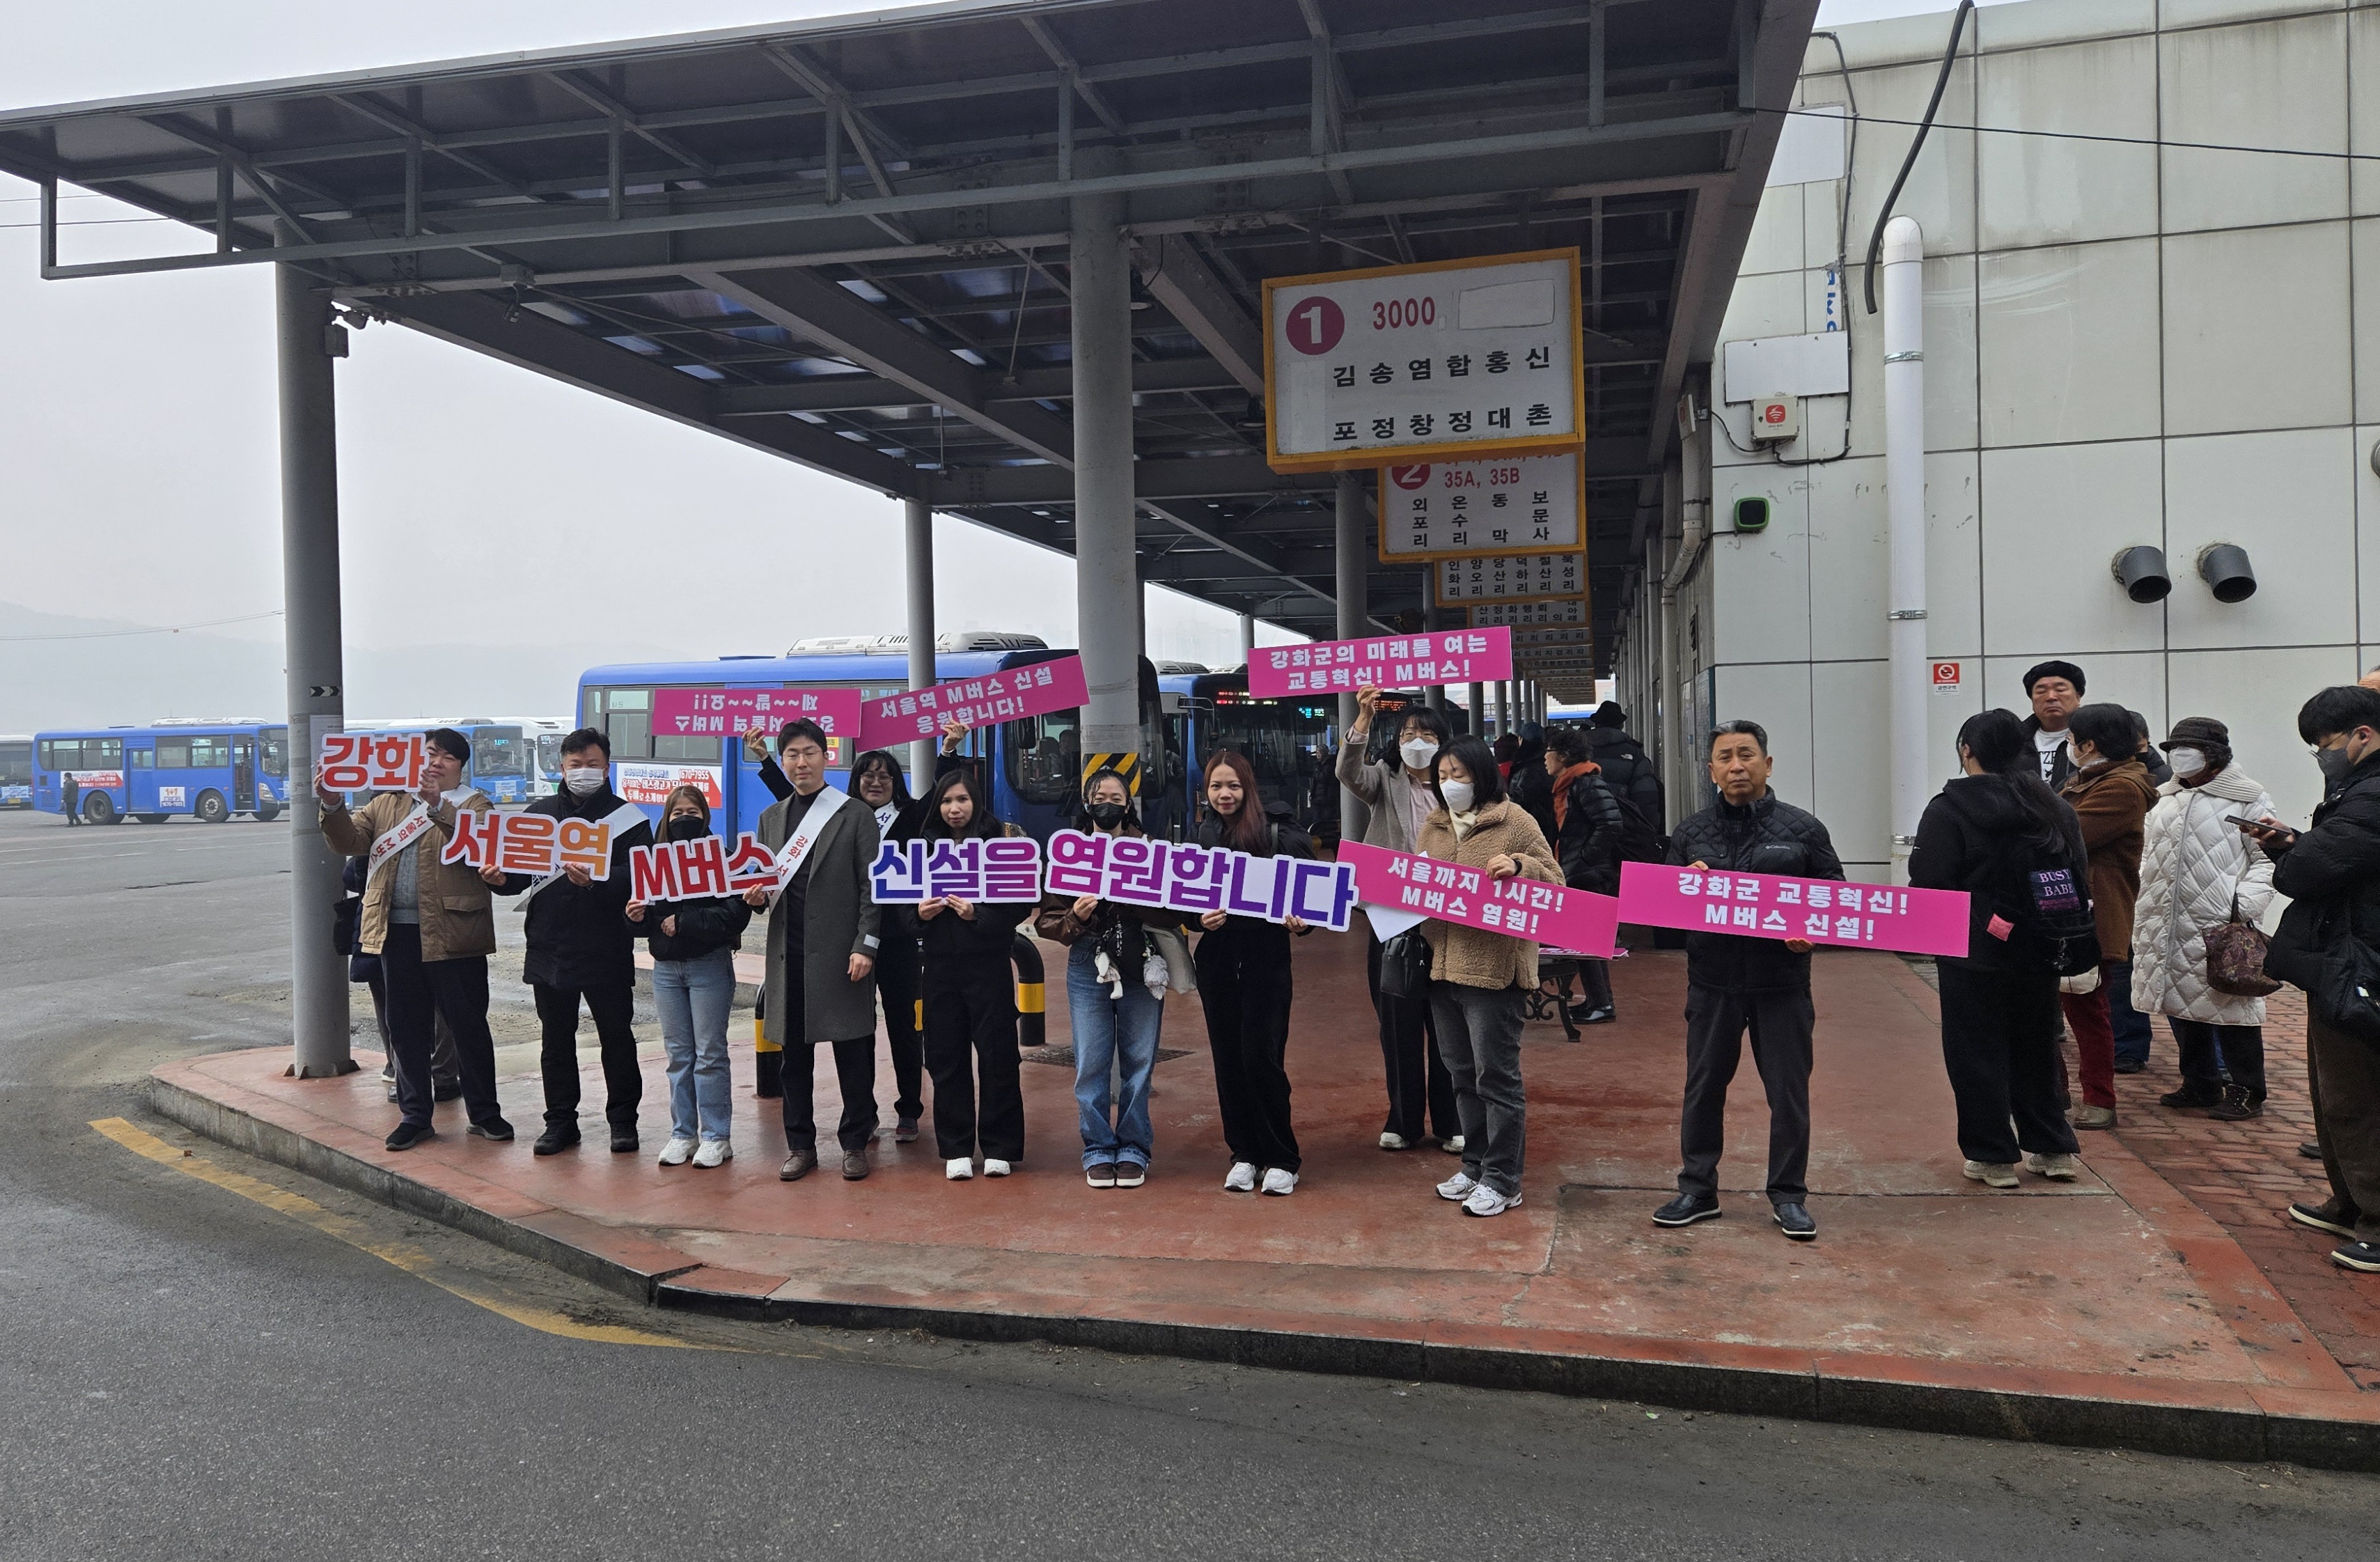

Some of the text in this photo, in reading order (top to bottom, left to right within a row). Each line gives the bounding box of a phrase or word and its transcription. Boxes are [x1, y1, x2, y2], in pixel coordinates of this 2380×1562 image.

[1301, 306, 1322, 344] 1
[1372, 297, 1435, 330] 3000
[1444, 467, 1520, 488] 35A, 35B
[1271, 634, 1487, 669] 강화군의 미래를 여는
[881, 666, 1053, 719] 서울역 M버스 신설
[1288, 659, 1470, 690] 교통혁신! M버스!
[675, 714, 724, 732] M버스
[917, 696, 1024, 734] 응원합니다!
[324, 736, 425, 788] 강화
[678, 768, 709, 780] 1670-7955
[398, 815, 427, 842] 서울역
[446, 813, 611, 877] 서울역
[633, 836, 779, 901] M버스
[872, 841, 1036, 899] 신설을
[1050, 834, 1354, 927] 염원합니다
[1388, 857, 1564, 912] 서울까지 1시간!
[2038, 868, 2071, 883] BUSY
[1401, 886, 1539, 934] M버스 염원!
[1678, 873, 1909, 915] 강화군 교통혁신!
[1705, 904, 1874, 941] M버스 신설!
